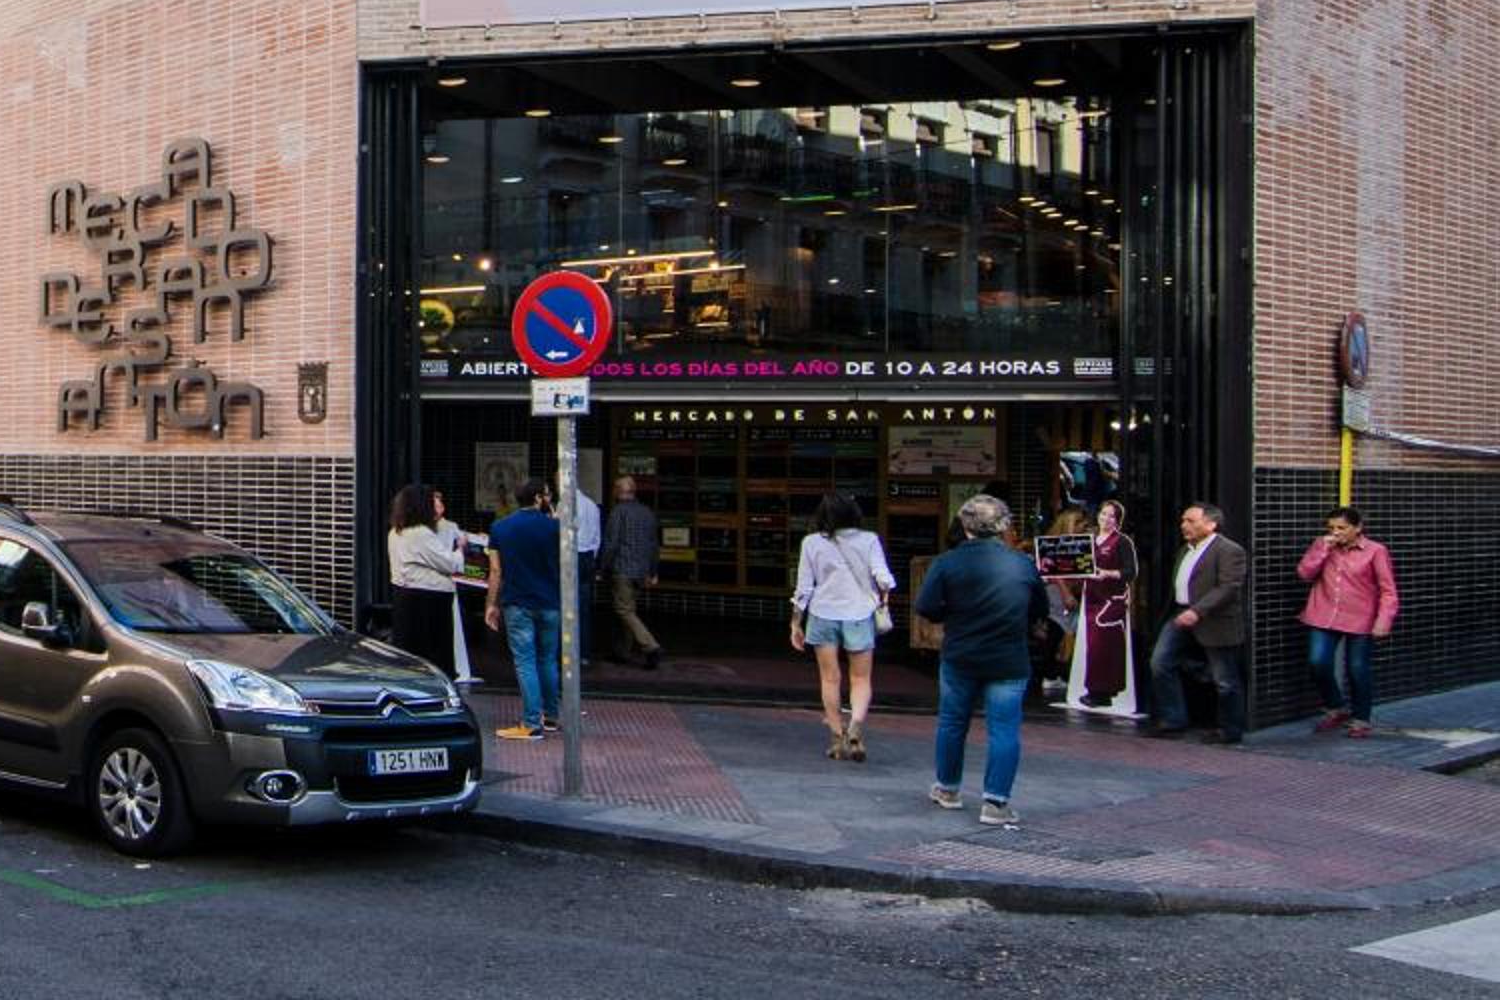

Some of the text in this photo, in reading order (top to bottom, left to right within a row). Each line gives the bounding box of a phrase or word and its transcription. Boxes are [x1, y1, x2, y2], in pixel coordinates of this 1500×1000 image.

[592, 362, 636, 377] DOS
[640, 362, 683, 376] LOS
[688, 359, 739, 376] DÍAS
[743, 362, 785, 376] DEL
[791, 359, 839, 376] AÑO
[844, 361, 876, 376] DE
[885, 361, 913, 376] 10
[918, 361, 936, 376] A
[942, 361, 973, 376] 24
[980, 361, 1061, 376] HORAS
[633, 410, 754, 422] MERCADO
[774, 409, 805, 421] DE
[381, 752, 415, 772] 1251
